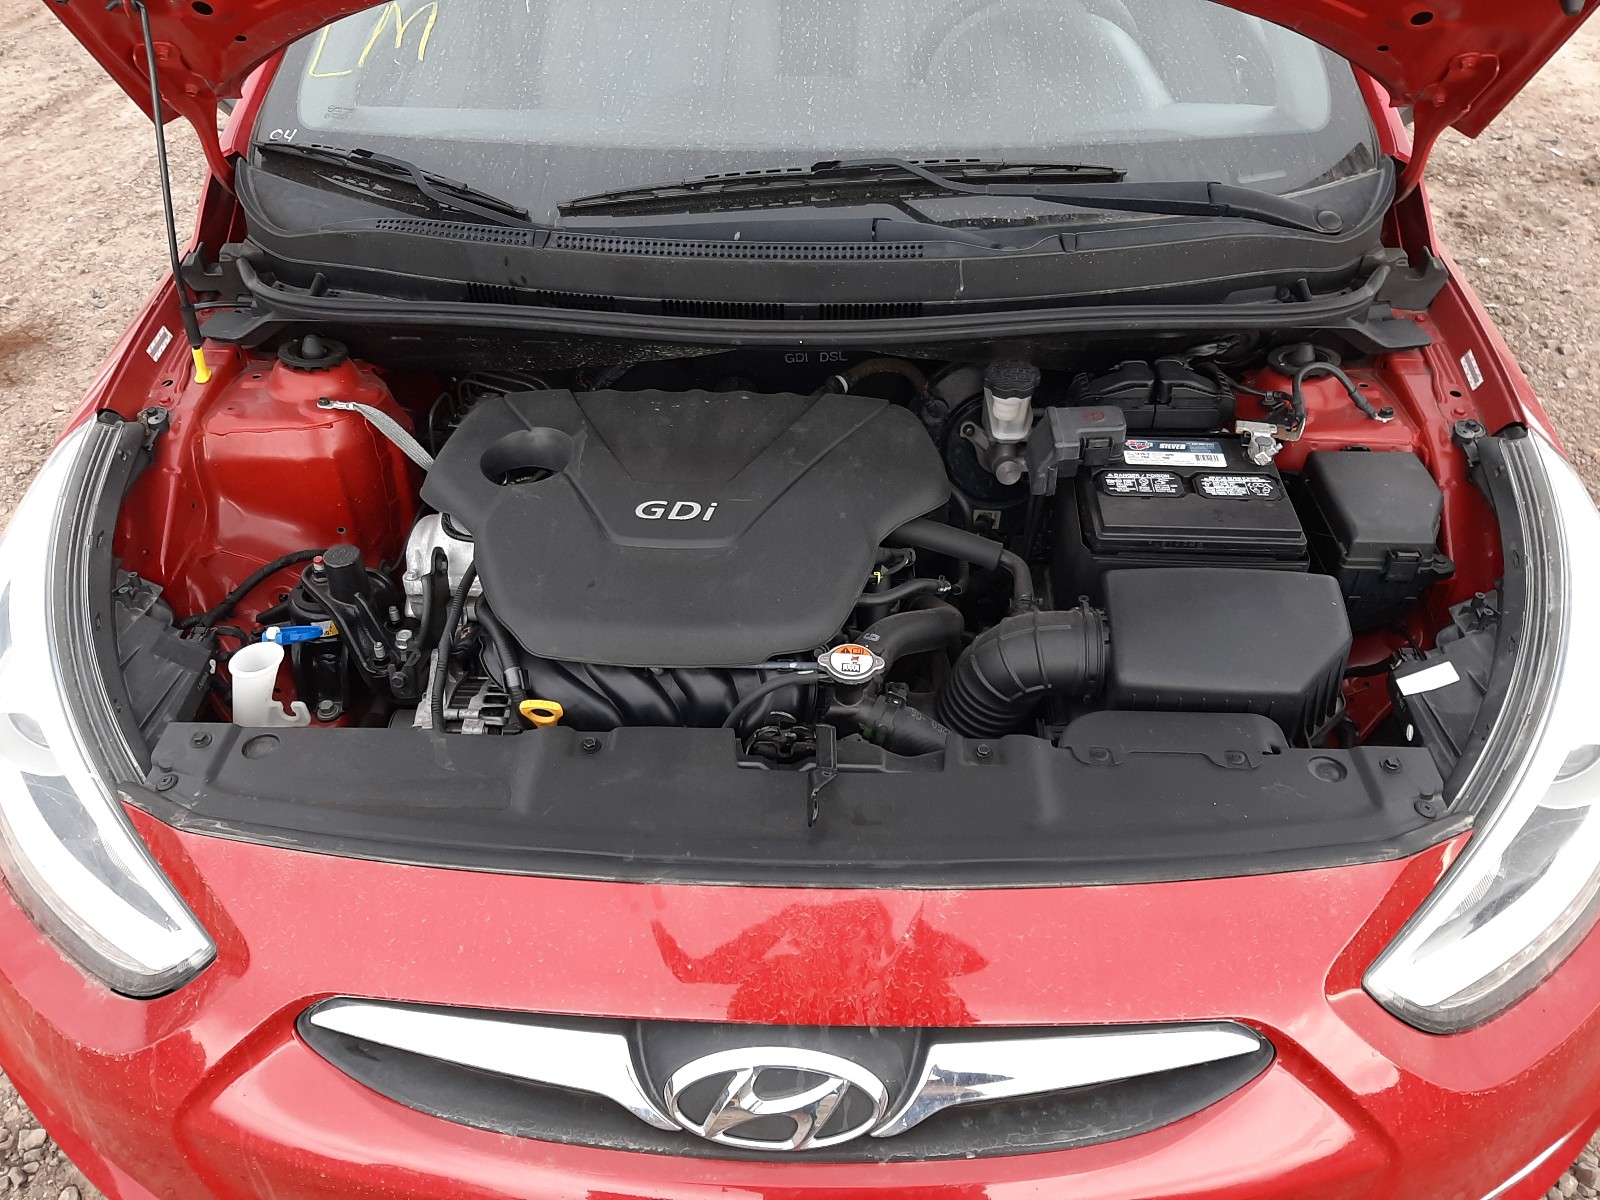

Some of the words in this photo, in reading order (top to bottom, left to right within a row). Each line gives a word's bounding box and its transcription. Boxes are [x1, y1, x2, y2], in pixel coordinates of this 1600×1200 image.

[784, 352, 809, 364] GDI
[819, 350, 849, 363] DSL
[635, 500, 718, 521] GDi
